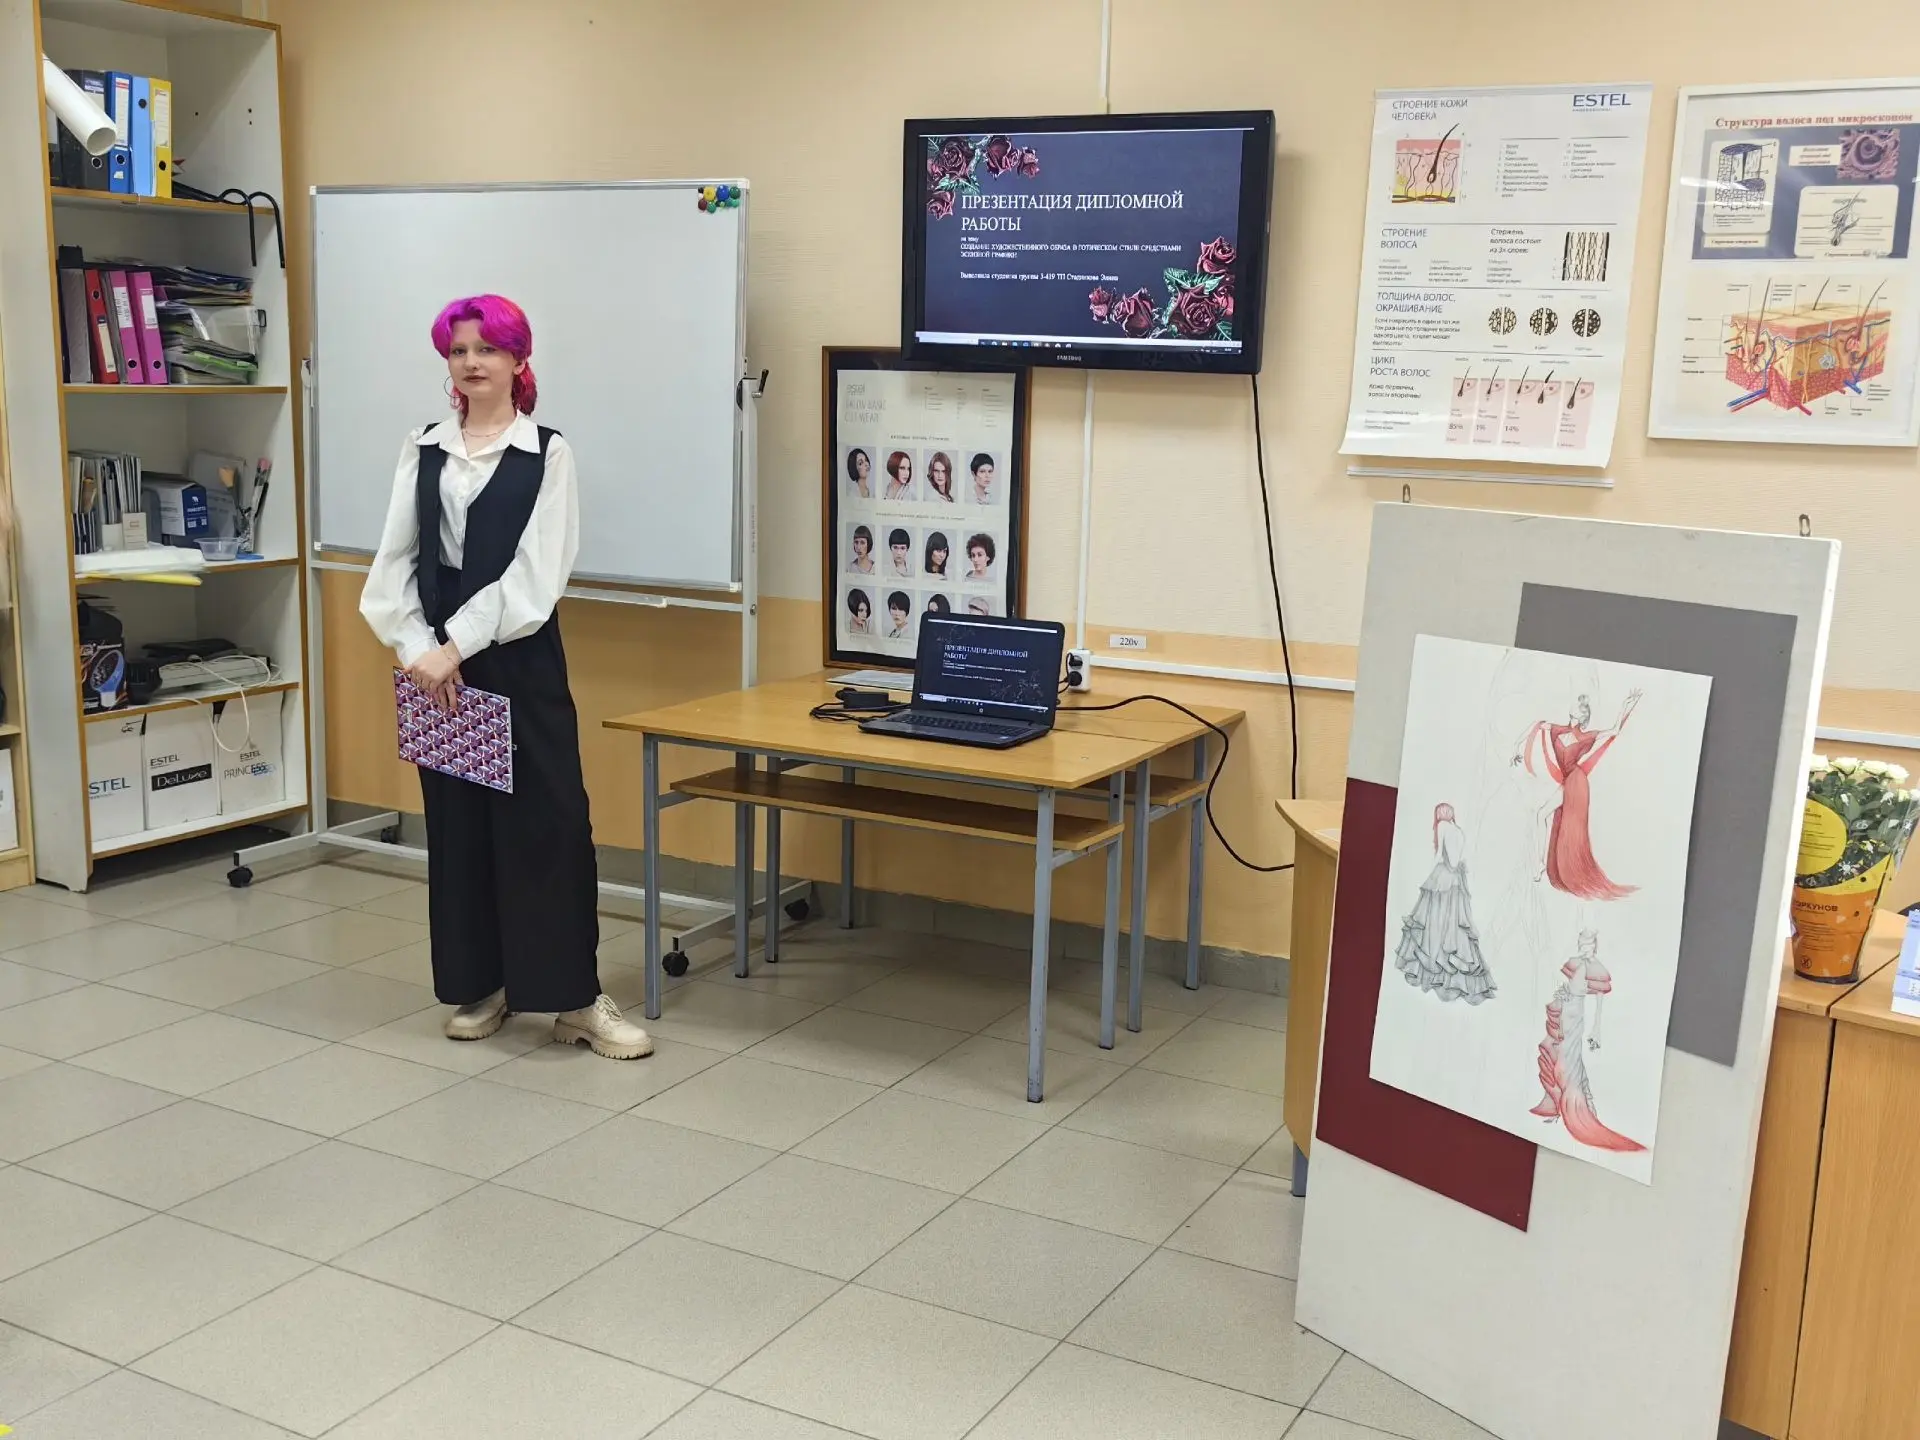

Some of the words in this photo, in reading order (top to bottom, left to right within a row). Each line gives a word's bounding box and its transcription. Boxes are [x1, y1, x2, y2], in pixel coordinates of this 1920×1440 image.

[1392, 99, 1439, 110] СТРОЕНИЕ
[1440, 98, 1468, 109] КОЖИ
[1572, 93, 1632, 107] ESTEL
[1391, 111, 1437, 121] ЧЕЛОВЕКА
[1715, 117, 1772, 129] Структура
[1776, 117, 1812, 125] волоса
[1815, 116, 1835, 124] под
[1837, 114, 1914, 124] микроскопом
[961, 194, 1072, 212] ПРЕЗЕНТАЦИЯ
[1075, 190, 1184, 212] ДИПЛОМНОЙ
[961, 216, 1021, 231] РАБОТЫ
[1381, 228, 1428, 238] СТРОЕНИЕ
[1380, 240, 1418, 249] ВОЛОСА
[1377, 291, 1421, 302] ТОЛЩИНА
[1423, 293, 1456, 303] ВОЛОС,
[1375, 303, 1443, 314] ОКРАШИВАНИЕ
[1371, 356, 1396, 365] ЦИКЛ
[1370, 367, 1399, 376] РОСТА
[1400, 368, 1432, 378] ВОЛОС
[150, 754, 180, 766] ESTEL
[239, 750, 261, 760] ESTEL
[89, 777, 131, 795] STEL
[1795, 900, 1838, 912] ОРКУНОВ
